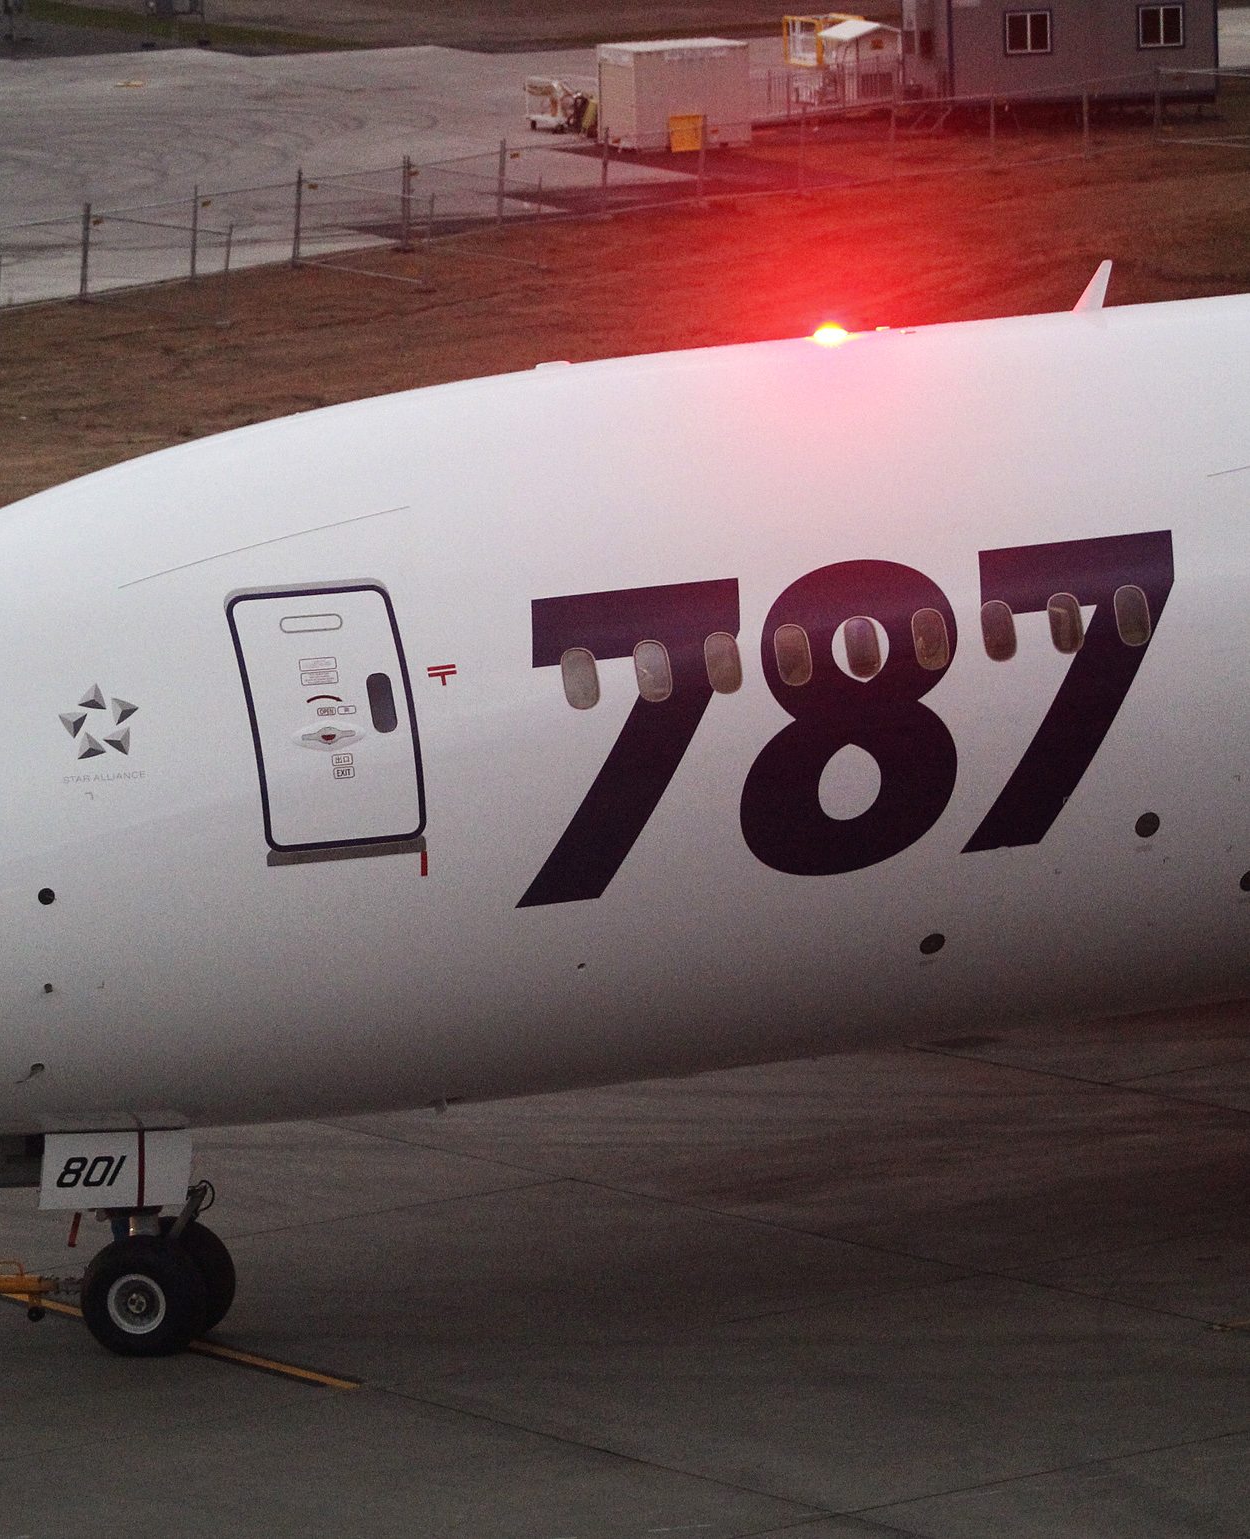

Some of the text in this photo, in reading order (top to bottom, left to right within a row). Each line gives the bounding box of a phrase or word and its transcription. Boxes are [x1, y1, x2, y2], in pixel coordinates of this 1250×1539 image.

[515, 530, 1175, 908] 787
[63, 770, 146, 784] STAR ALLIANCE
[336, 769, 351, 777] EXIT
[56, 1154, 127, 1189] 801
